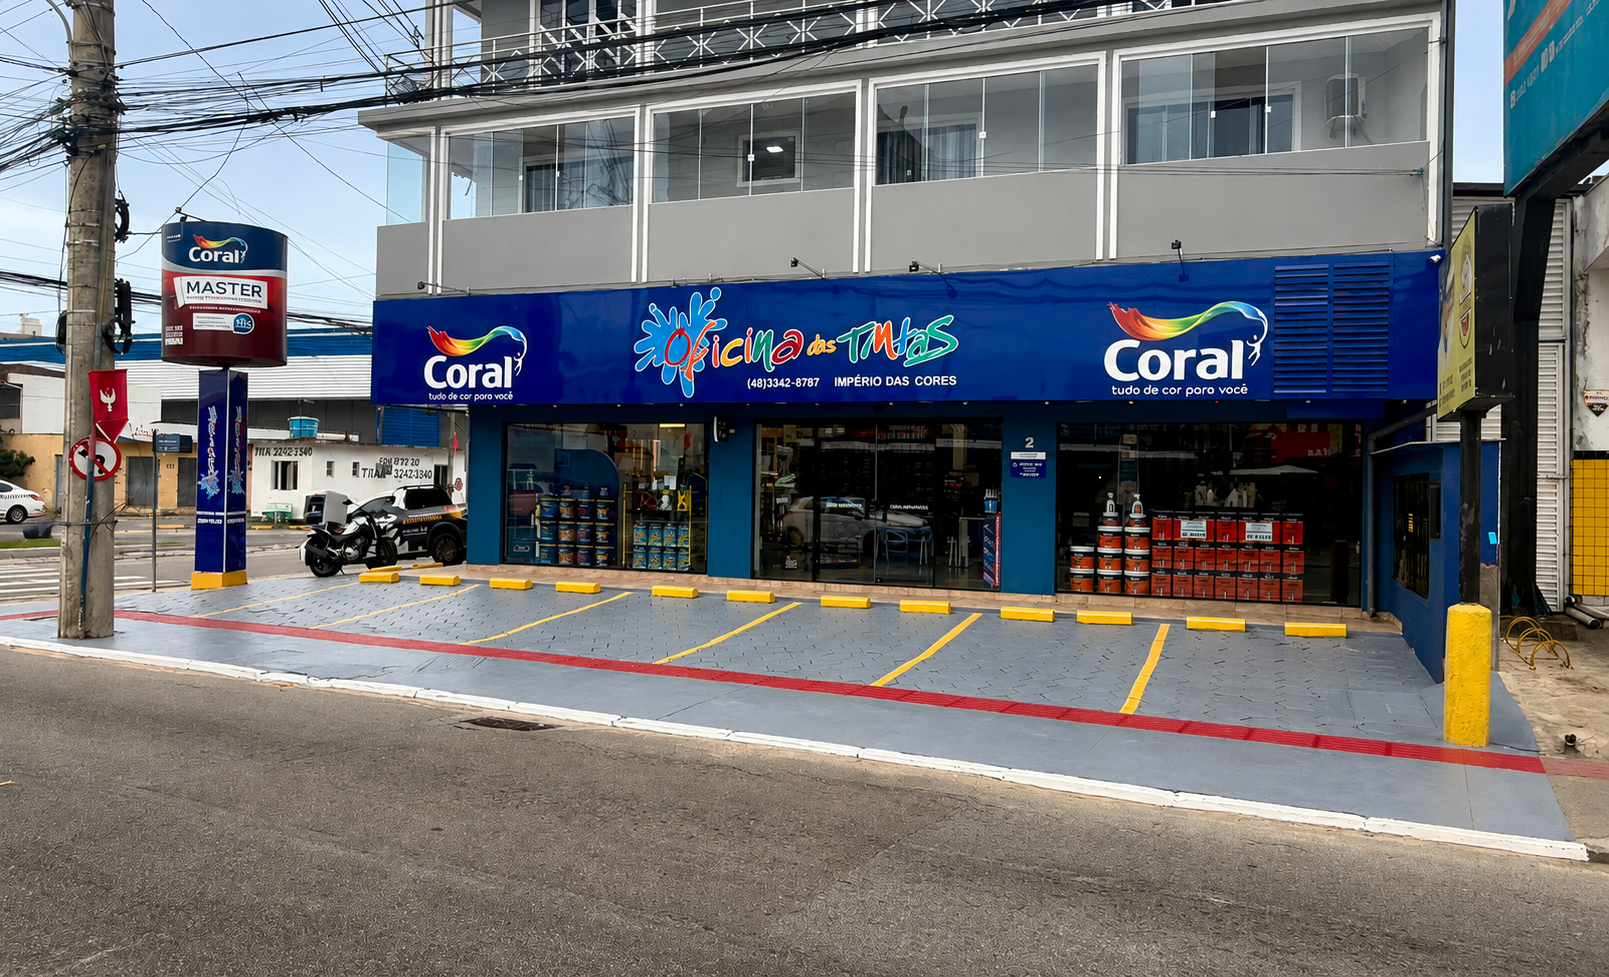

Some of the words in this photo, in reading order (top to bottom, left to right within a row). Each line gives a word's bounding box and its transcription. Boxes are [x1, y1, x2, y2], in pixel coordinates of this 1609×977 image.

[188, 247, 239, 263] Coral
[186, 281, 262, 298] MASTER
[664, 321, 804, 381] Oficina
[806, 334, 837, 356] das
[1104, 339, 1244, 382] Coral
[423, 355, 513, 389] Coral
[747, 376, 820, 390] (48)3342-8787
[834, 373, 882, 387] IMPÉRIO
[886, 376, 910, 387] DAS
[914, 375, 957, 387] CORES
[1112, 384, 1140, 395] tudo
[1143, 384, 1159, 395] de
[1162, 386, 1181, 395] cor
[1218, 383, 1248, 395] você
[428, 392, 447, 401] tudo
[448, 392, 458, 400] de
[459, 393, 472, 401] cor
[494, 391, 513, 401] você
[1025, 436, 1035, 448] 2
